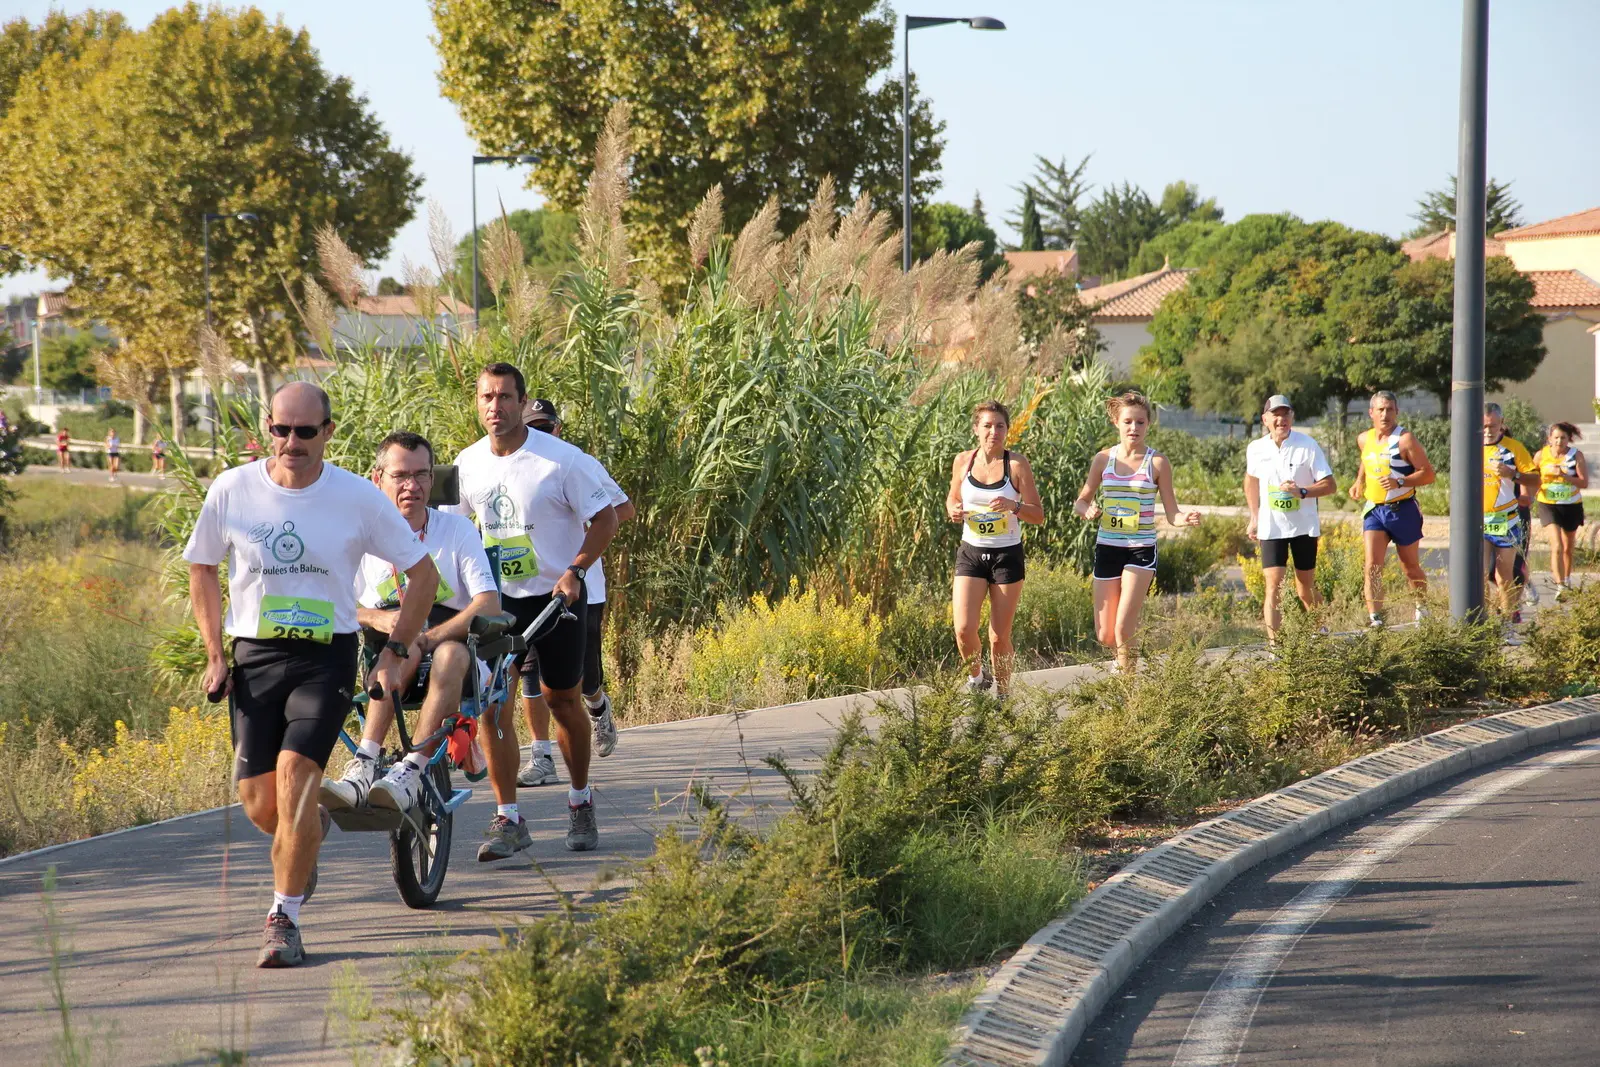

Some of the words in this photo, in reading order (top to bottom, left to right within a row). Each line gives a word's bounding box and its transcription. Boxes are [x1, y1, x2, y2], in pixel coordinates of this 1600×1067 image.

[1273, 499, 1293, 509] 420
[978, 522, 995, 534] 92
[1110, 516, 1124, 529] 91
[289, 563, 299, 574] de
[300, 563, 330, 576] Balaruc
[500, 560, 524, 577] 62
